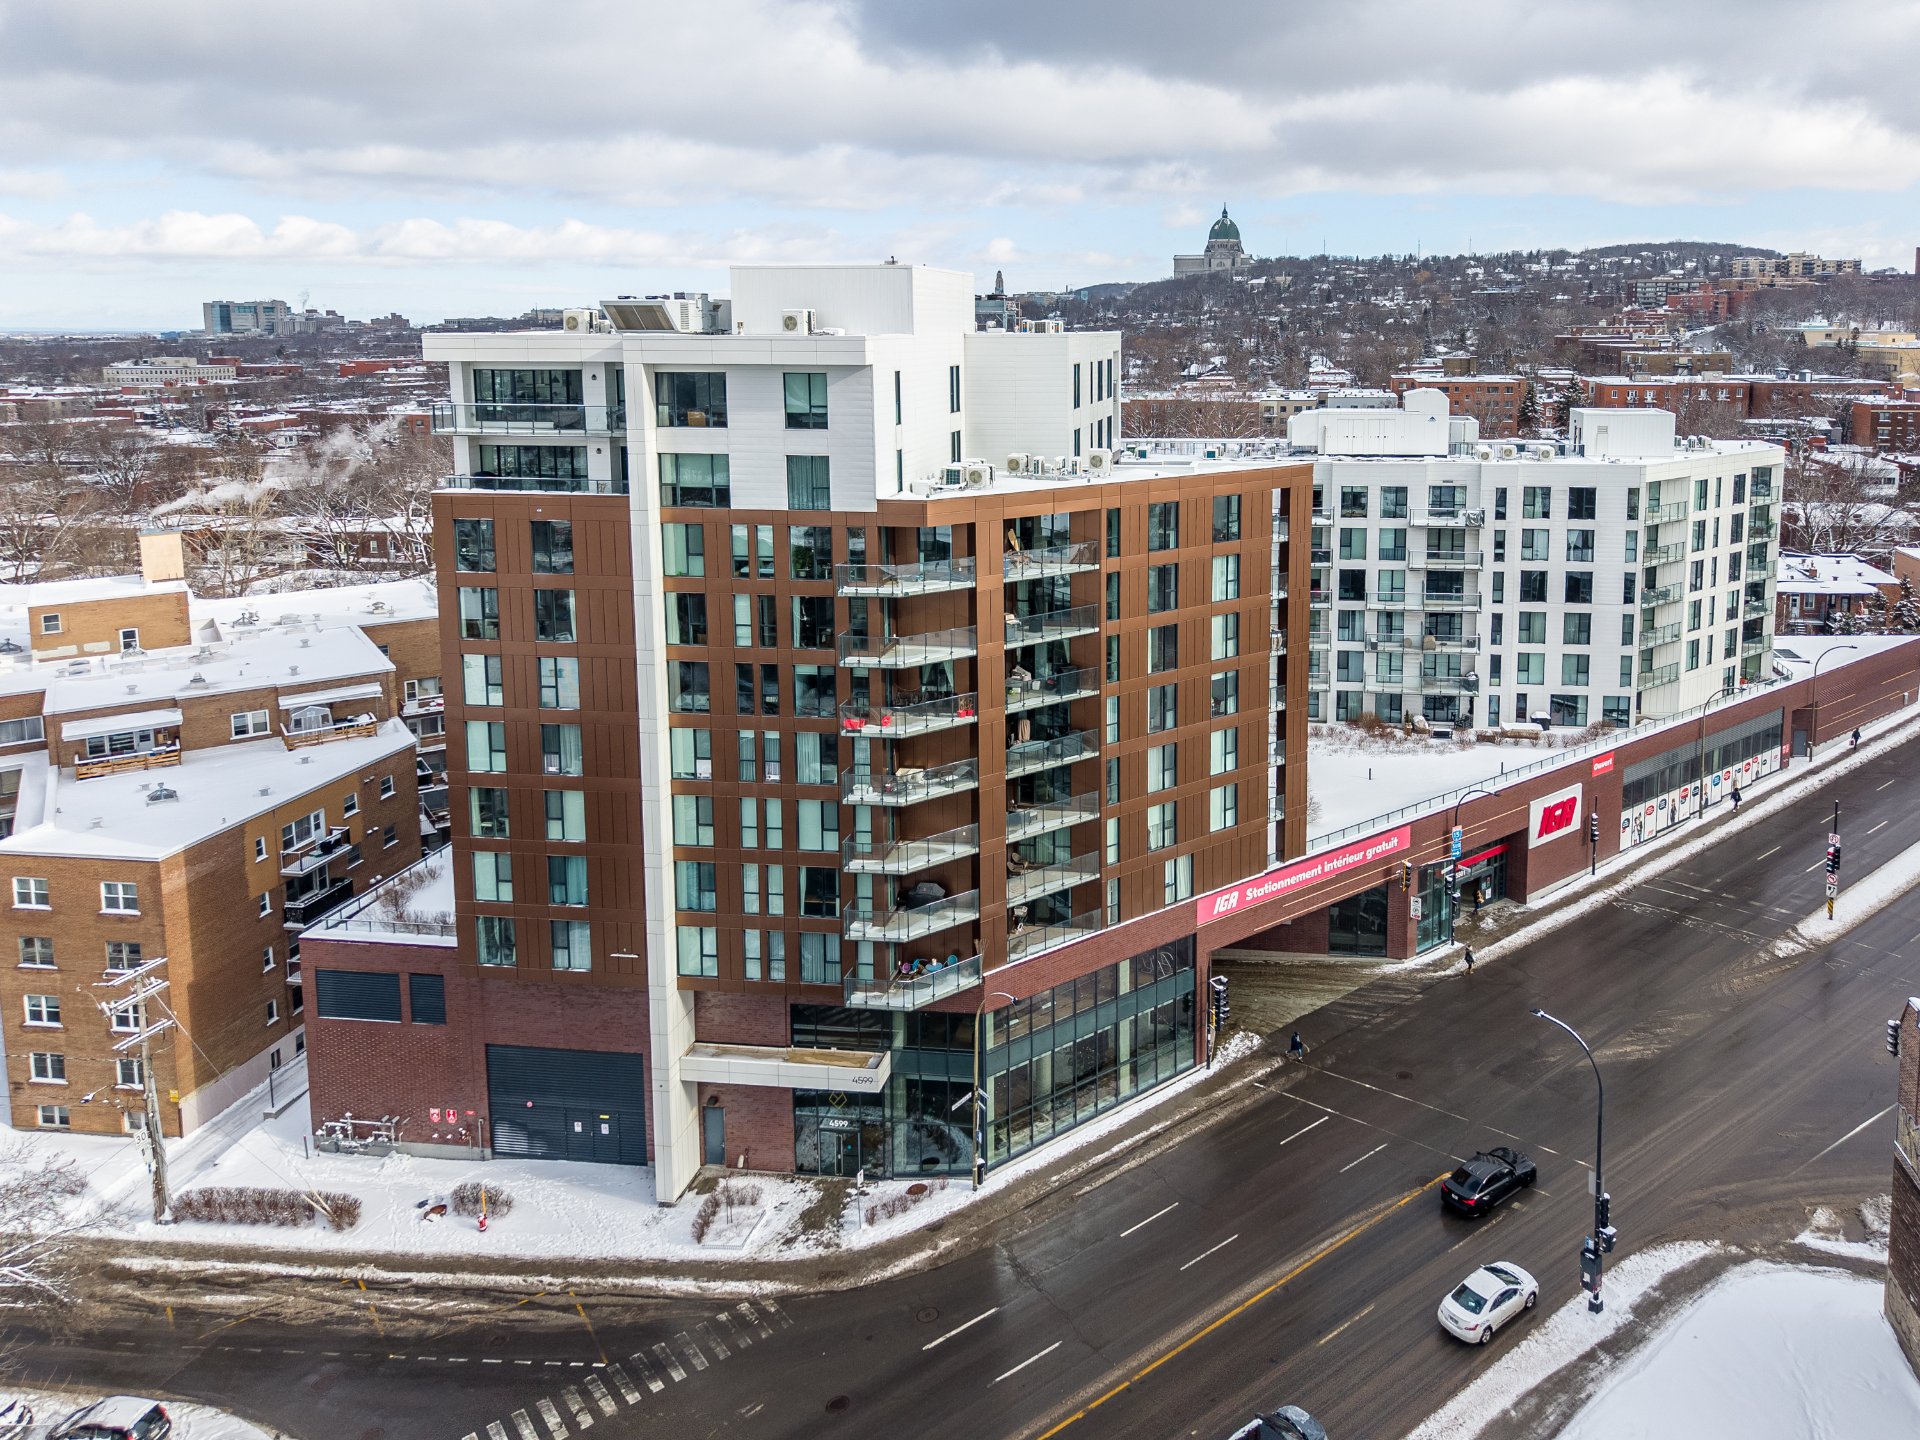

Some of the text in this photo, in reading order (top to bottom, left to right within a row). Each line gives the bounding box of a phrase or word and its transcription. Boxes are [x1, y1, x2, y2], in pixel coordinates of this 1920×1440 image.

[1593, 758, 1613, 771] Ouvert
[1537, 796, 1577, 839] IGA
[1213, 837, 1398, 915] IGA Stationnement intérieur gratuit
[852, 1076, 874, 1085] 4599
[829, 1119, 849, 1128] 4599
[136, 1131, 147, 1145] 30
